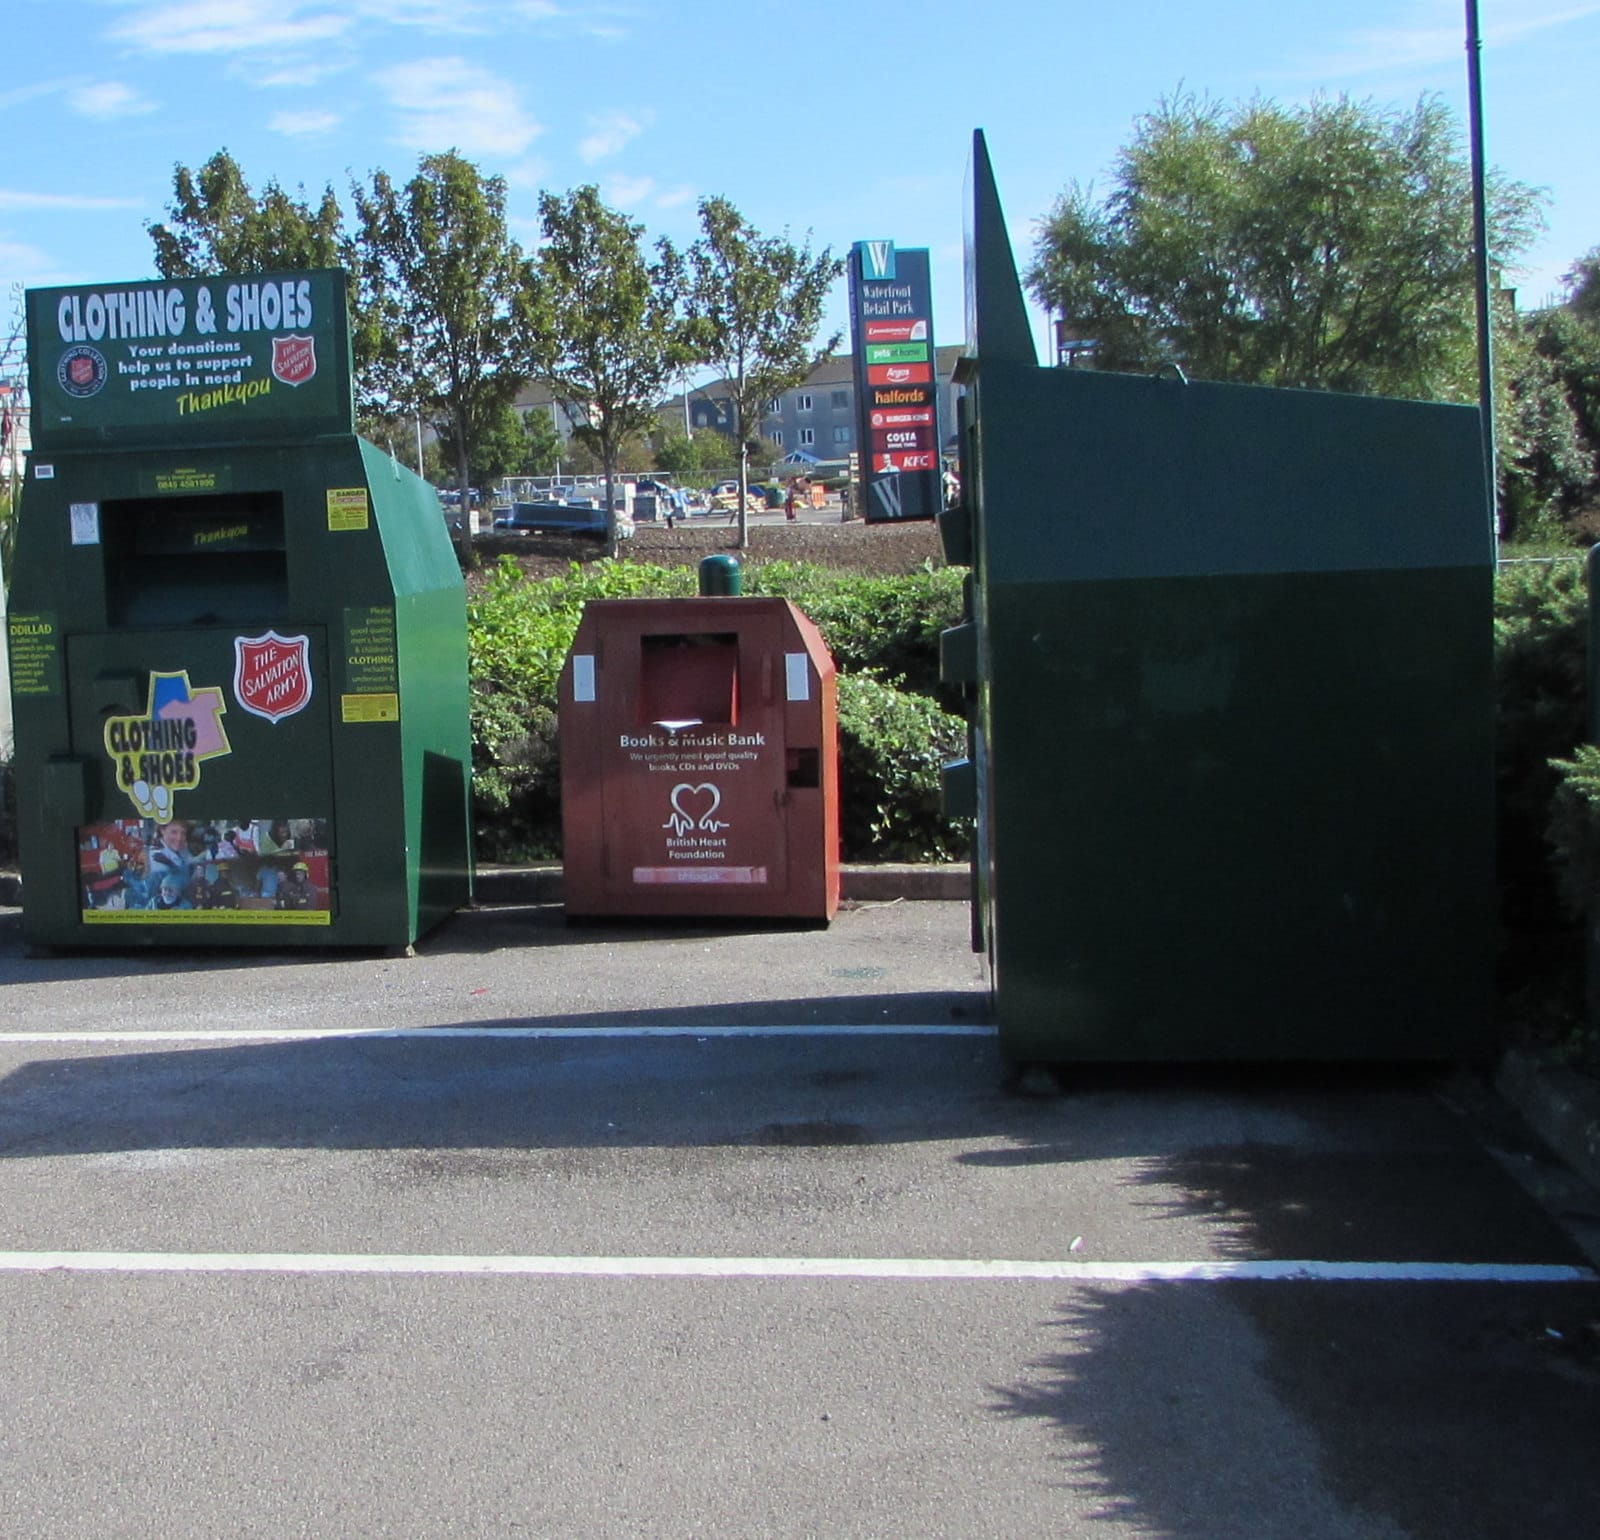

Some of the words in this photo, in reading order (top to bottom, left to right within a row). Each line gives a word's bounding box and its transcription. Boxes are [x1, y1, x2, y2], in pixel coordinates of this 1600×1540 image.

[866, 241, 889, 278] W
[863, 284, 912, 299] Waterfront
[58, 288, 186, 342] CLOTHING
[195, 286, 217, 334] &
[226, 280, 312, 332] SHOES
[863, 300, 890, 316] Retail
[892, 299, 914, 315] Park
[128, 344, 163, 357] Your
[168, 340, 241, 355] donations
[282, 343, 297, 357] THE
[873, 348, 891, 360] pets
[118, 360, 151, 375] help
[155, 361, 172, 372] us
[176, 359, 191, 371] to
[196, 355, 253, 372] support
[277, 346, 310, 373] SALVATION
[289, 356, 310, 378] ARMY
[130, 374, 180, 392] people
[185, 373, 200, 386] in
[204, 370, 241, 384] need
[886, 367, 910, 379] Argos
[176, 376, 271, 416] Thankyou
[875, 389, 924, 404] halfords
[886, 432, 917, 443] COSTA
[903, 455, 929, 468] KFC
[10, 624, 52, 636] DDILLAD
[254, 646, 278, 671] THE
[348, 656, 394, 665] CLOTHING
[244, 650, 300, 697] SALVATION
[266, 671, 298, 706] ARMY
[110, 717, 197, 753] CLOTHING
[620, 734, 664, 748] Books
[668, 734, 679, 747] &
[682, 733, 725, 747] Music
[728, 732, 766, 747] Bank
[629, 752, 643, 761] We
[644, 751, 679, 762] urgently
[681, 751, 702, 760] need
[703, 751, 726, 761] good
[728, 751, 758, 761] quality
[122, 755, 134, 786] &
[140, 752, 195, 785] SHOES
[678, 762, 696, 771] CDs
[697, 761, 714, 771] and
[715, 761, 740, 771] DVDs
[666, 838, 697, 847] British
[699, 837, 727, 847] Heart
[668, 850, 725, 860] Foundation
